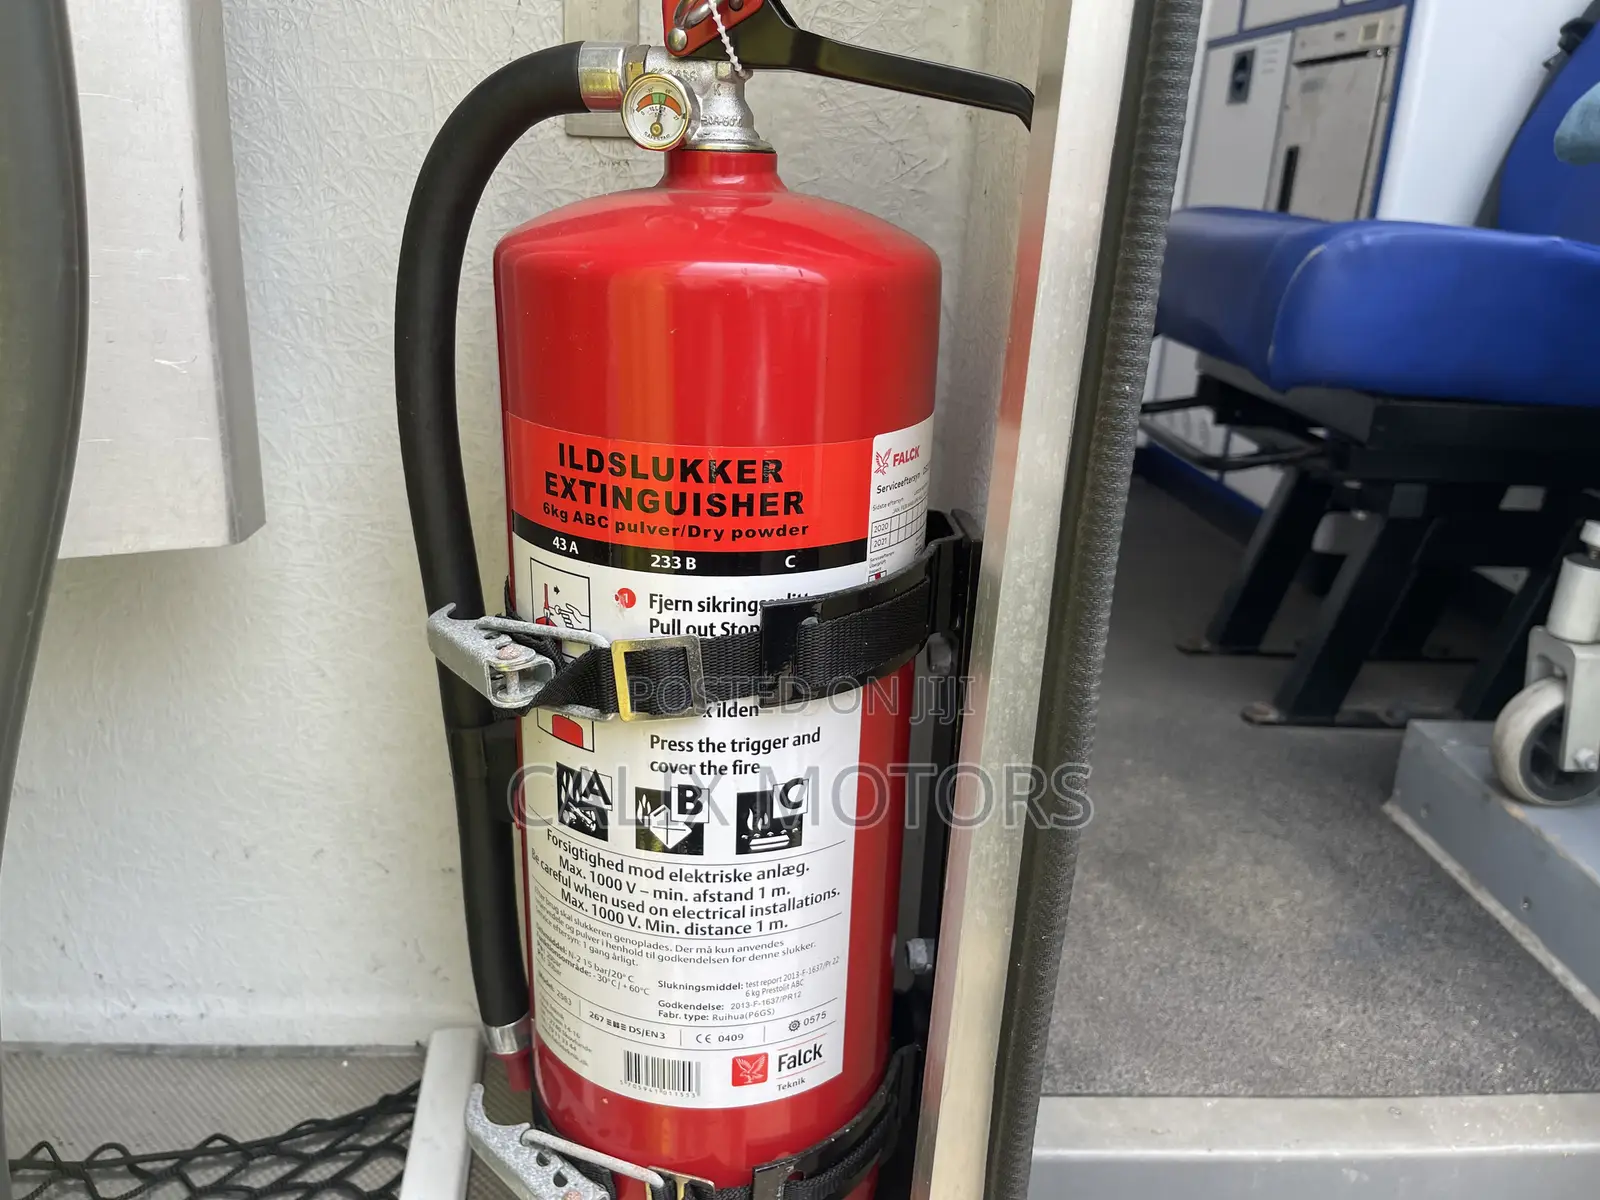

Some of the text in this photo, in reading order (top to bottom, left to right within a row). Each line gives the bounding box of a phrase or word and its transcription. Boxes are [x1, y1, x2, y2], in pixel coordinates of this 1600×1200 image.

[558, 443, 784, 484] ILDSLUKKER
[892, 445, 921, 467] FALCK
[544, 471, 804, 518] EXTINGUISHER
[543, 502, 809, 542] 6kg ABC pulver/Dry powder
[874, 522, 889, 534] 2020
[552, 536, 579, 554] 43 A
[651, 554, 697, 570] 233 B
[784, 555, 796, 568] C
[649, 594, 693, 615] Fjern
[650, 618, 681, 635] Pull
[685, 623, 717, 637] out
[717, 701, 759, 718] ilden
[650, 726, 821, 756] Press the trigger and
[650, 759, 760, 775] cover the fire
[677, 783, 704, 816] B
[546, 828, 810, 883] Forsigtighed mod elektriske anlæg.
[559, 855, 586, 880] Max.
[589, 870, 622, 891] 1000
[625, 882, 636, 894] V
[653, 888, 688, 902] min.
[693, 886, 754, 902] afstand
[758, 886, 766, 899] 1
[771, 885, 791, 897] m.
[540, 859, 571, 889] careful
[574, 881, 608, 905] when
[612, 897, 645, 914] used
[648, 905, 668, 917] on
[672, 905, 745, 919] electrical
[750, 887, 840, 917] installations.
[561, 888, 788, 936] Max. 1000 V. Min. distance 1 m.
[574, 917, 612, 939] slukkeren
[613, 934, 673, 953] genoplades.
[675, 944, 694, 953] Der
[715, 945, 735, 954] kun
[736, 940, 785, 953] anvendes
[576, 929, 600, 945] pulver
[605, 940, 643, 957] henhold
[645, 951, 656, 960] til
[657, 954, 730, 964] godkendelsen
[732, 955, 746, 963] for
[748, 952, 780, 962] denne
[588, 945, 611, 960] gang
[657, 980, 744, 992] Slukningsmiddel:
[745, 979, 760, 988] test
[760, 975, 783, 990] report
[657, 1000, 725, 1011] Godkendelse:
[588, 1010, 605, 1023] 267
[657, 1009, 682, 1020] Fabr.
[683, 1012, 710, 1022] type:
[802, 1010, 828, 1026] 0575
[717, 1033, 745, 1043] 0409
[777, 1043, 823, 1072] Falck
[776, 1078, 806, 1092] Teknik
